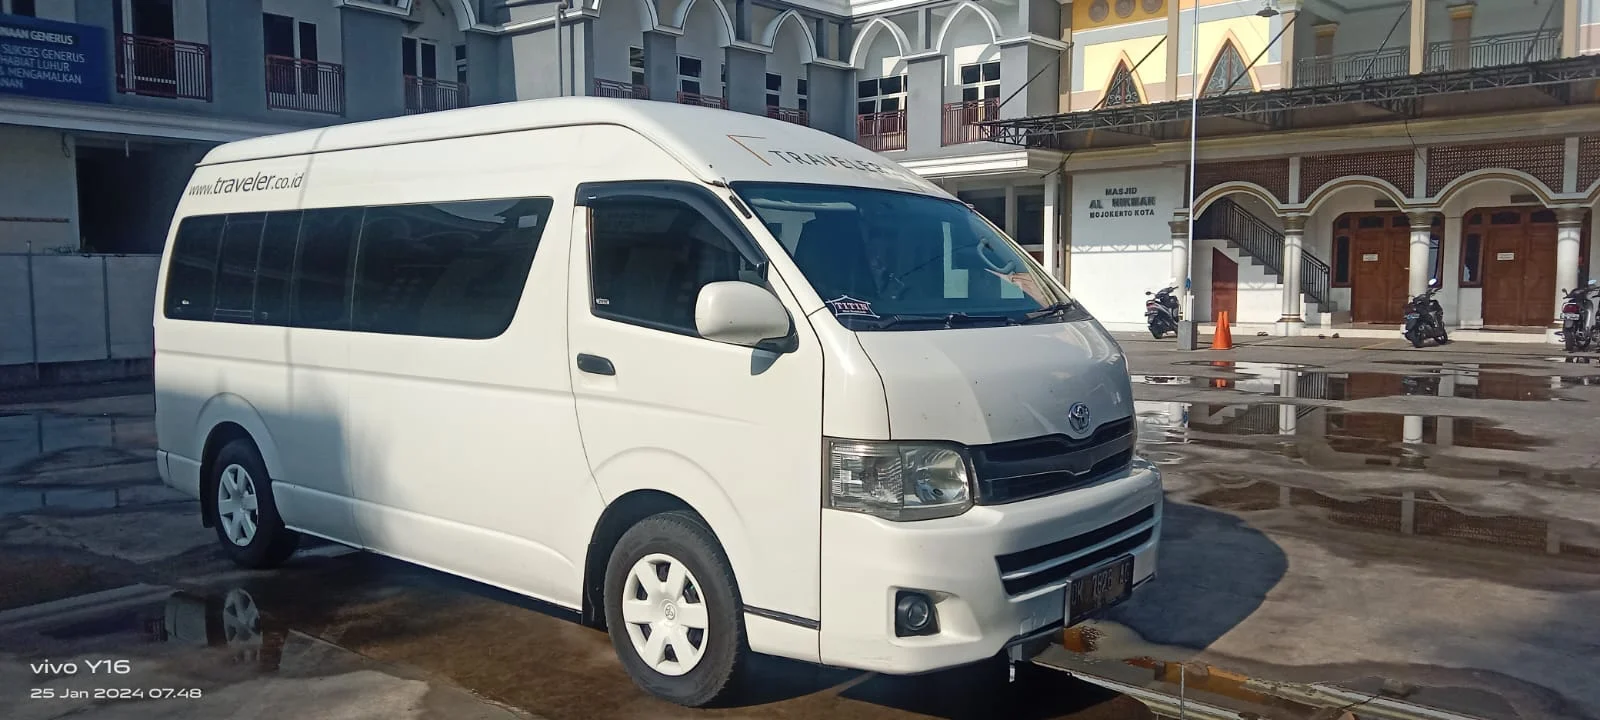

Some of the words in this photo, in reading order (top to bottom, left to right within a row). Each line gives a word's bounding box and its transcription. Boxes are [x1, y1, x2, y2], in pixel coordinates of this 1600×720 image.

[30, 30, 74, 45] GENERUS
[1, 44, 39, 58] SUKSES
[41, 48, 85, 63] GENERUS
[37, 60, 70, 73] LUHUR
[8, 67, 82, 85] MENGAMALKAN
[188, 171, 305, 196] www.traveler.co.id
[1105, 187, 1138, 196] MASJID
[1089, 199, 1103, 209] AL
[1090, 210, 1133, 219] MOJOKERTO
[1134, 209, 1155, 217] KOTA
[834, 302, 869, 311] TITIN
